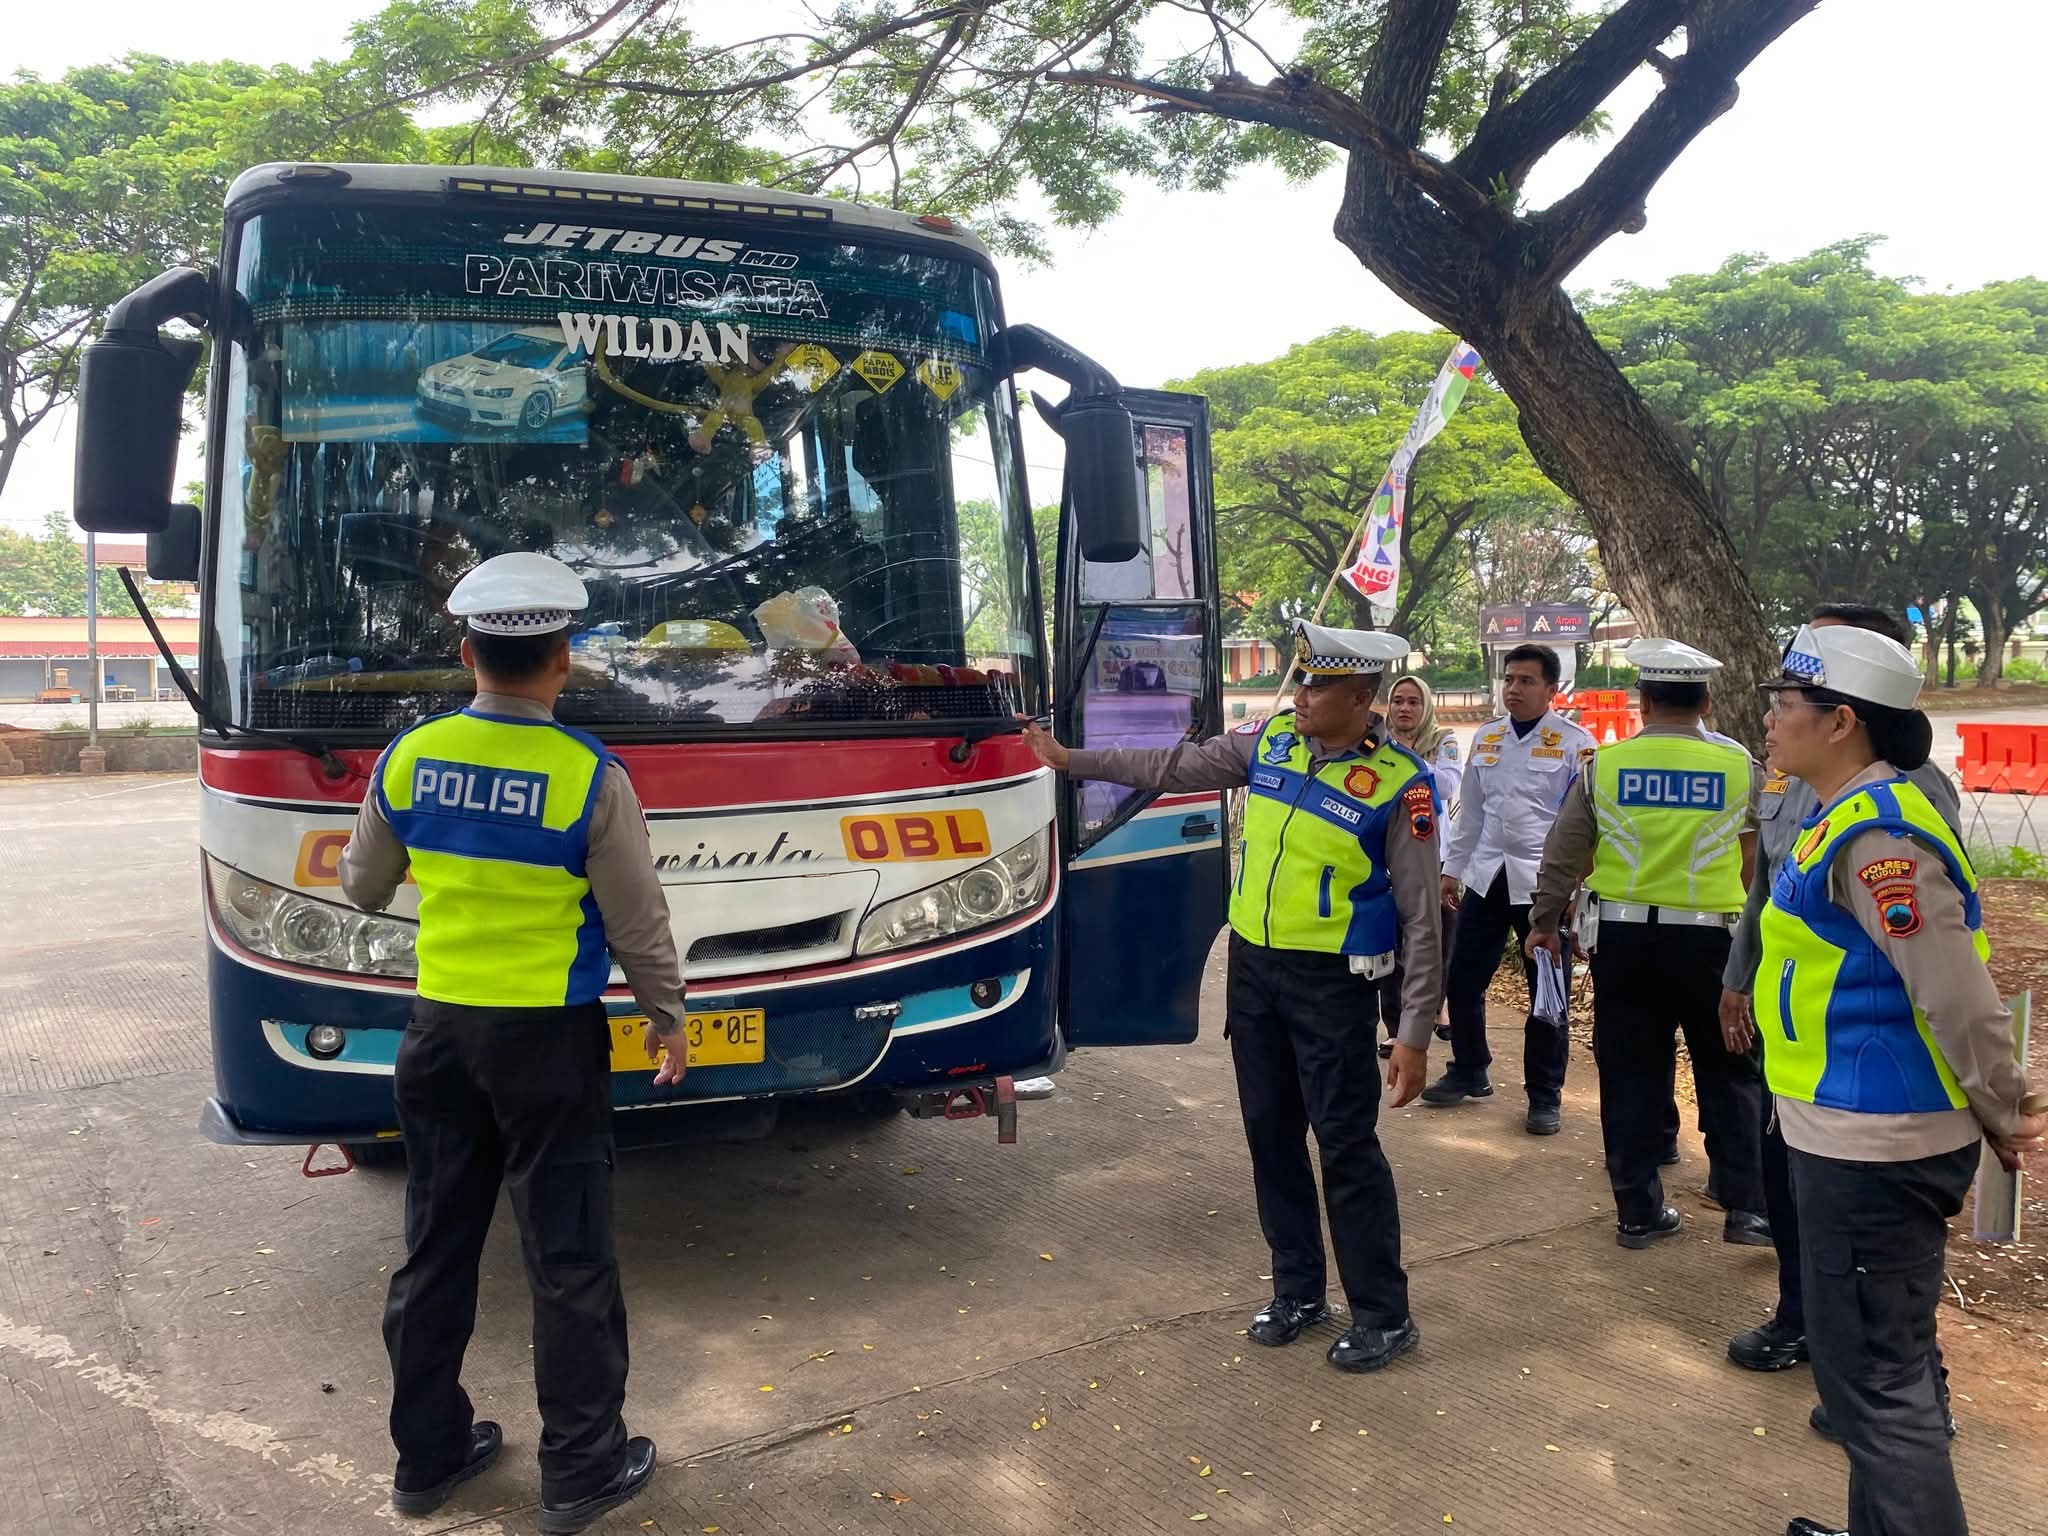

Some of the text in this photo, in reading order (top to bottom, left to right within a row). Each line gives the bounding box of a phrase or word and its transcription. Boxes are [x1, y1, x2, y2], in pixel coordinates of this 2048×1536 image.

[504, 223, 747, 263] JETBUS
[464, 254, 829, 319] PARIWISATA
[557, 311, 750, 365] WILDAN
[863, 358, 895, 369] PAPAH
[1555, 615, 1582, 625] Aroma
[415, 767, 542, 817] POLISI
[1623, 773, 1719, 805] POLISI
[1323, 799, 1360, 822] POLISI
[849, 815, 984, 860] OBL
[1861, 860, 1911, 879] POLRES
[1870, 868, 1902, 881] KUDUS
